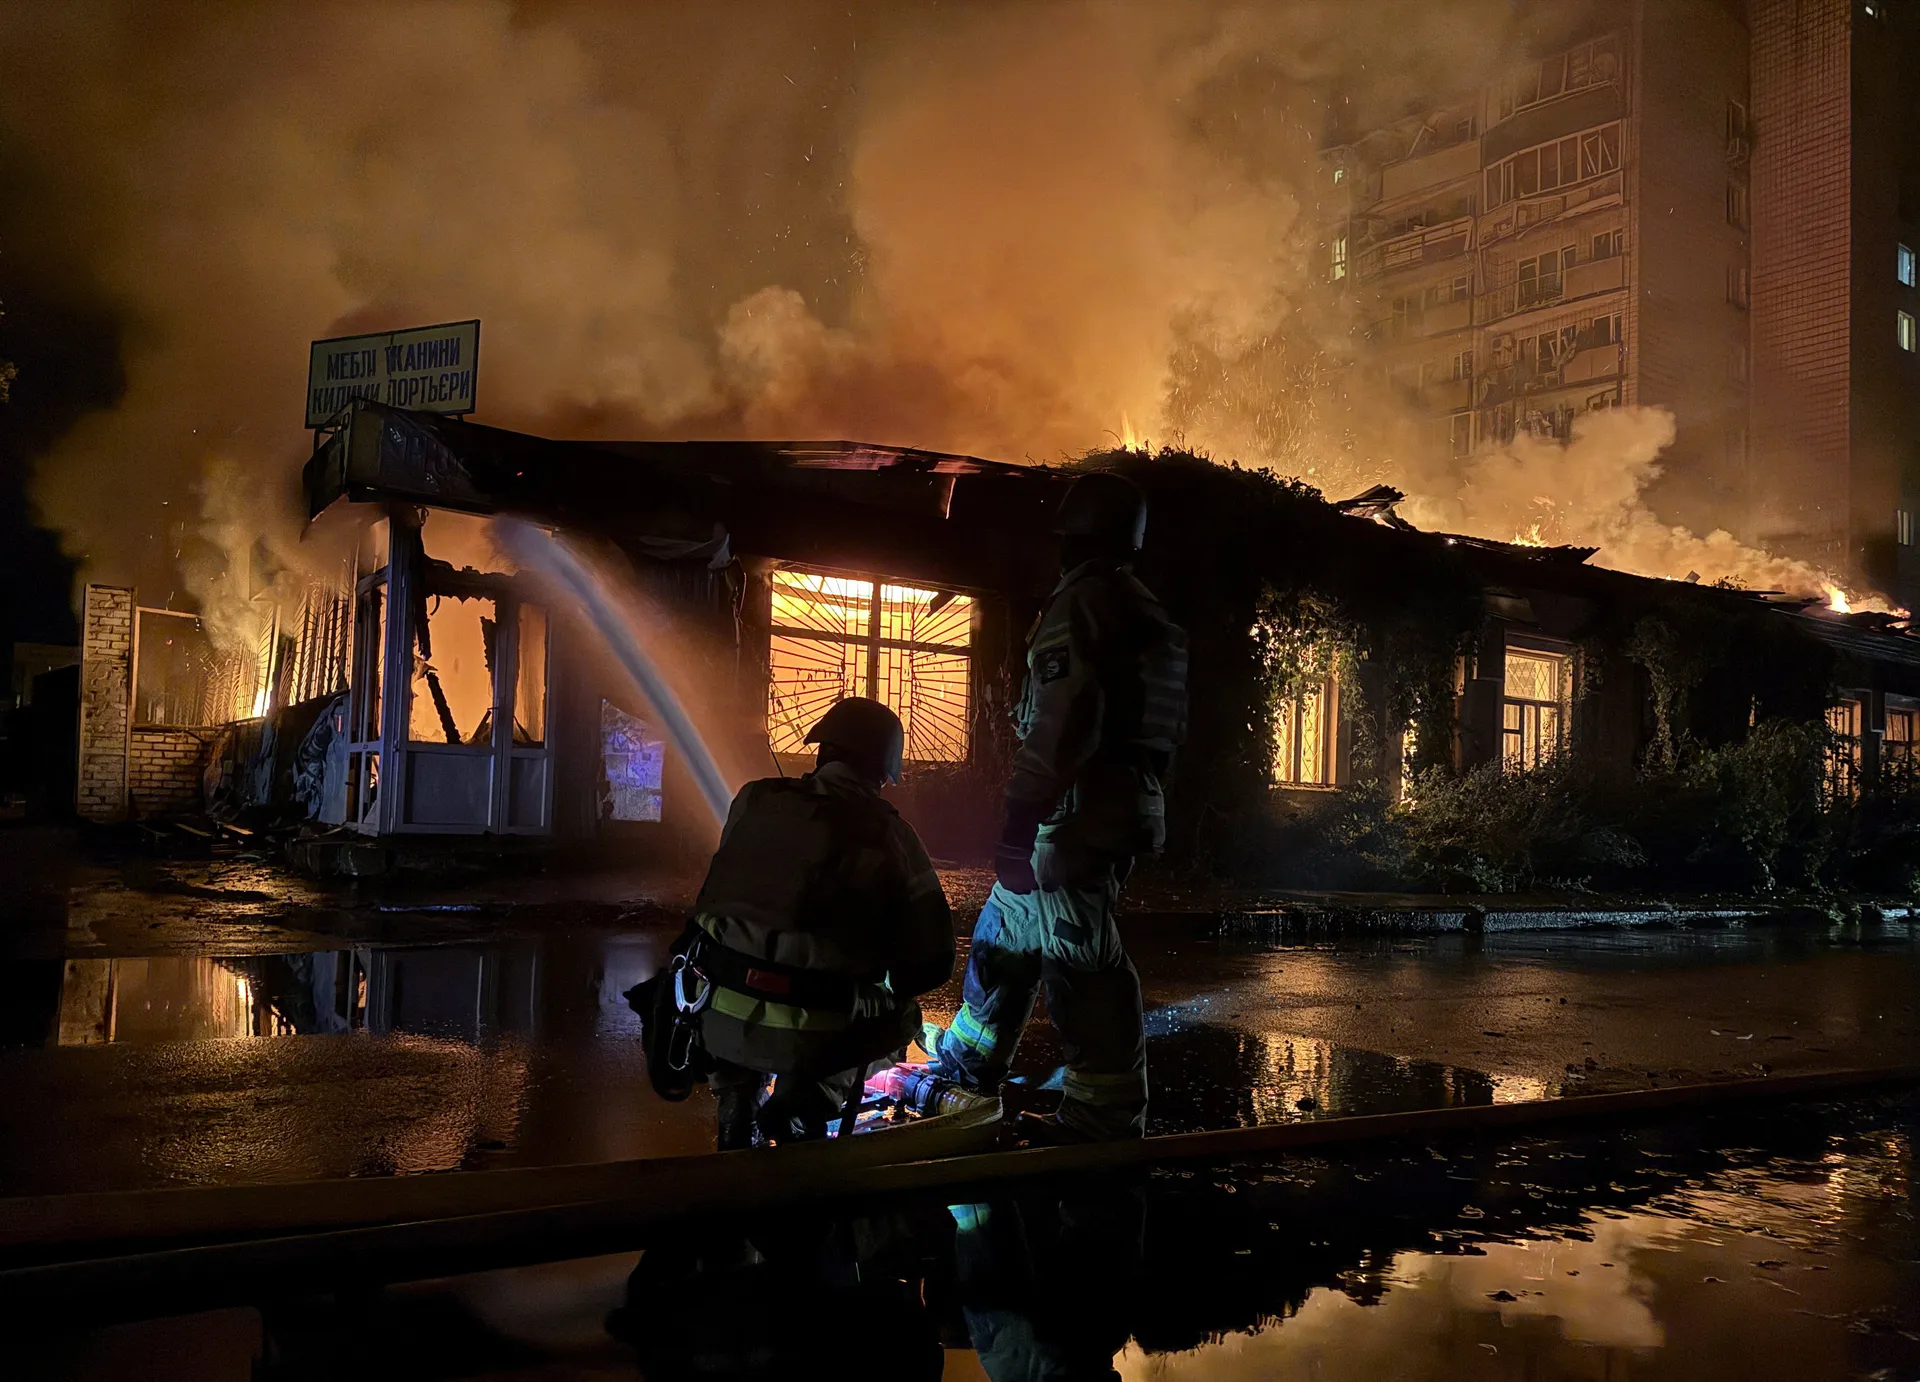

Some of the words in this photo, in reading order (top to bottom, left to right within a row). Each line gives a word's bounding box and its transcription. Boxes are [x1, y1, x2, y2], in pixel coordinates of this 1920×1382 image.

[328, 350, 376, 380] МЕБЛІ
[385, 338, 460, 371] ТКАНИНИ
[389, 371, 470, 407] ПОРТЬЄРИ
